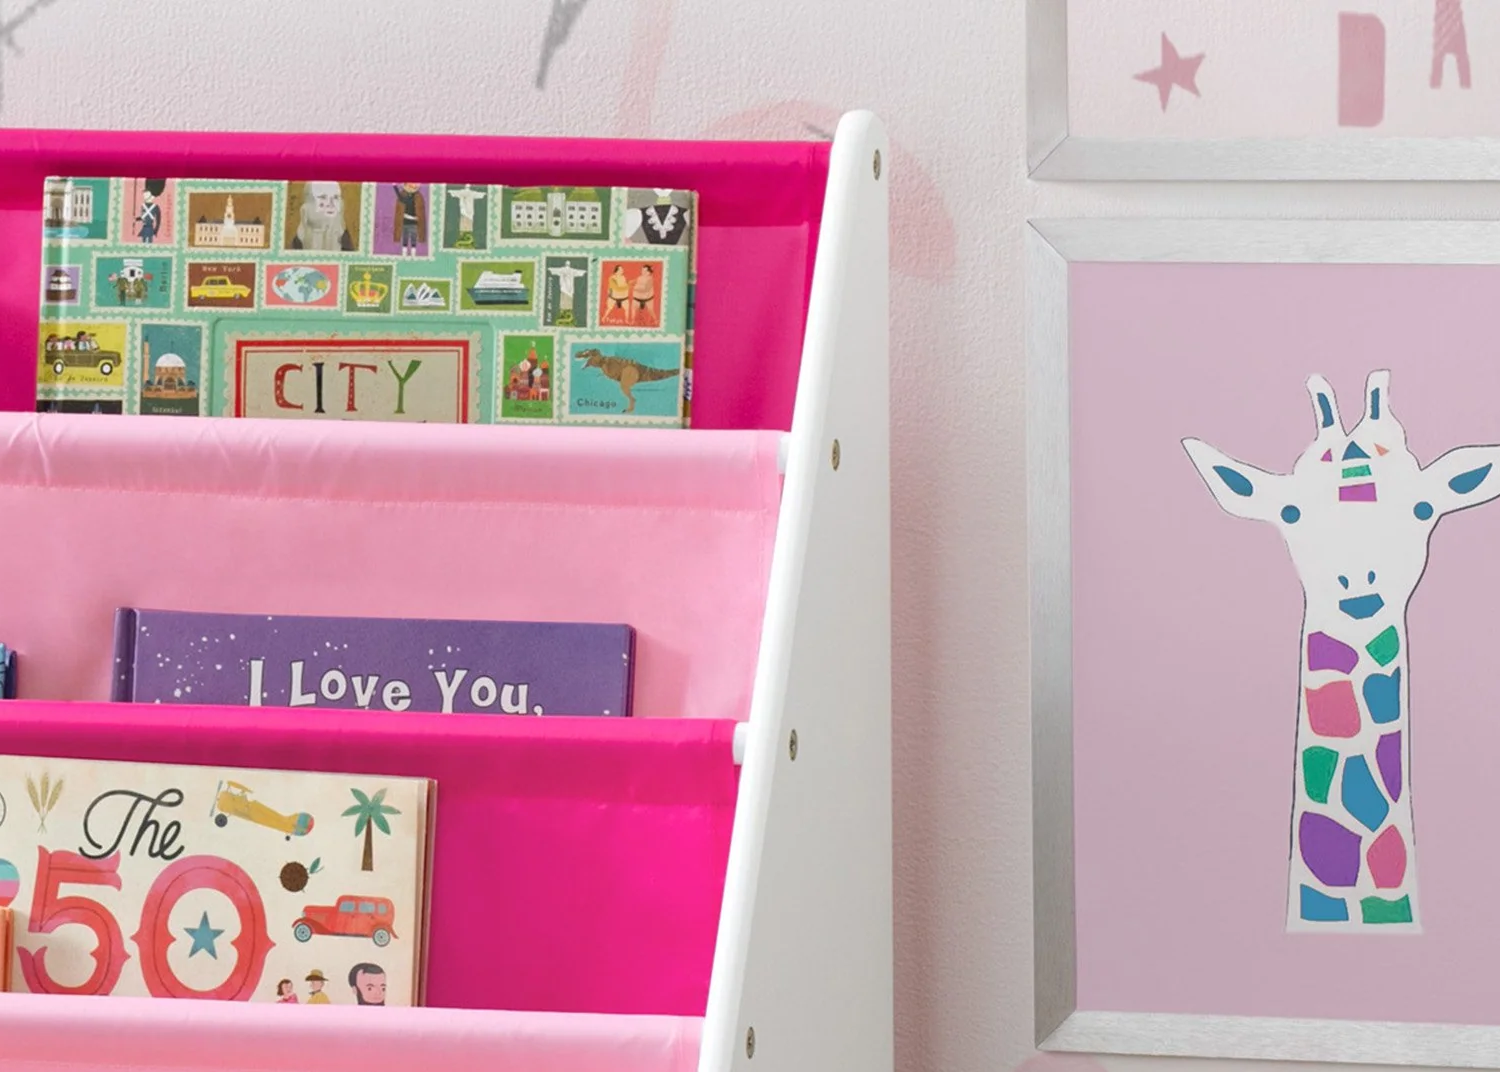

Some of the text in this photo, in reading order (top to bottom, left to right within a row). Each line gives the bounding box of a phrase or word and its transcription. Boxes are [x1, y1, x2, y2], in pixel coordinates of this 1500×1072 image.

[274, 359, 422, 414] CITY
[576, 398, 617, 409] Chicago
[249, 660, 263, 706] I
[289, 660, 412, 711] Love
[79, 788, 186, 861] The
[16, 845, 277, 1000] 50
